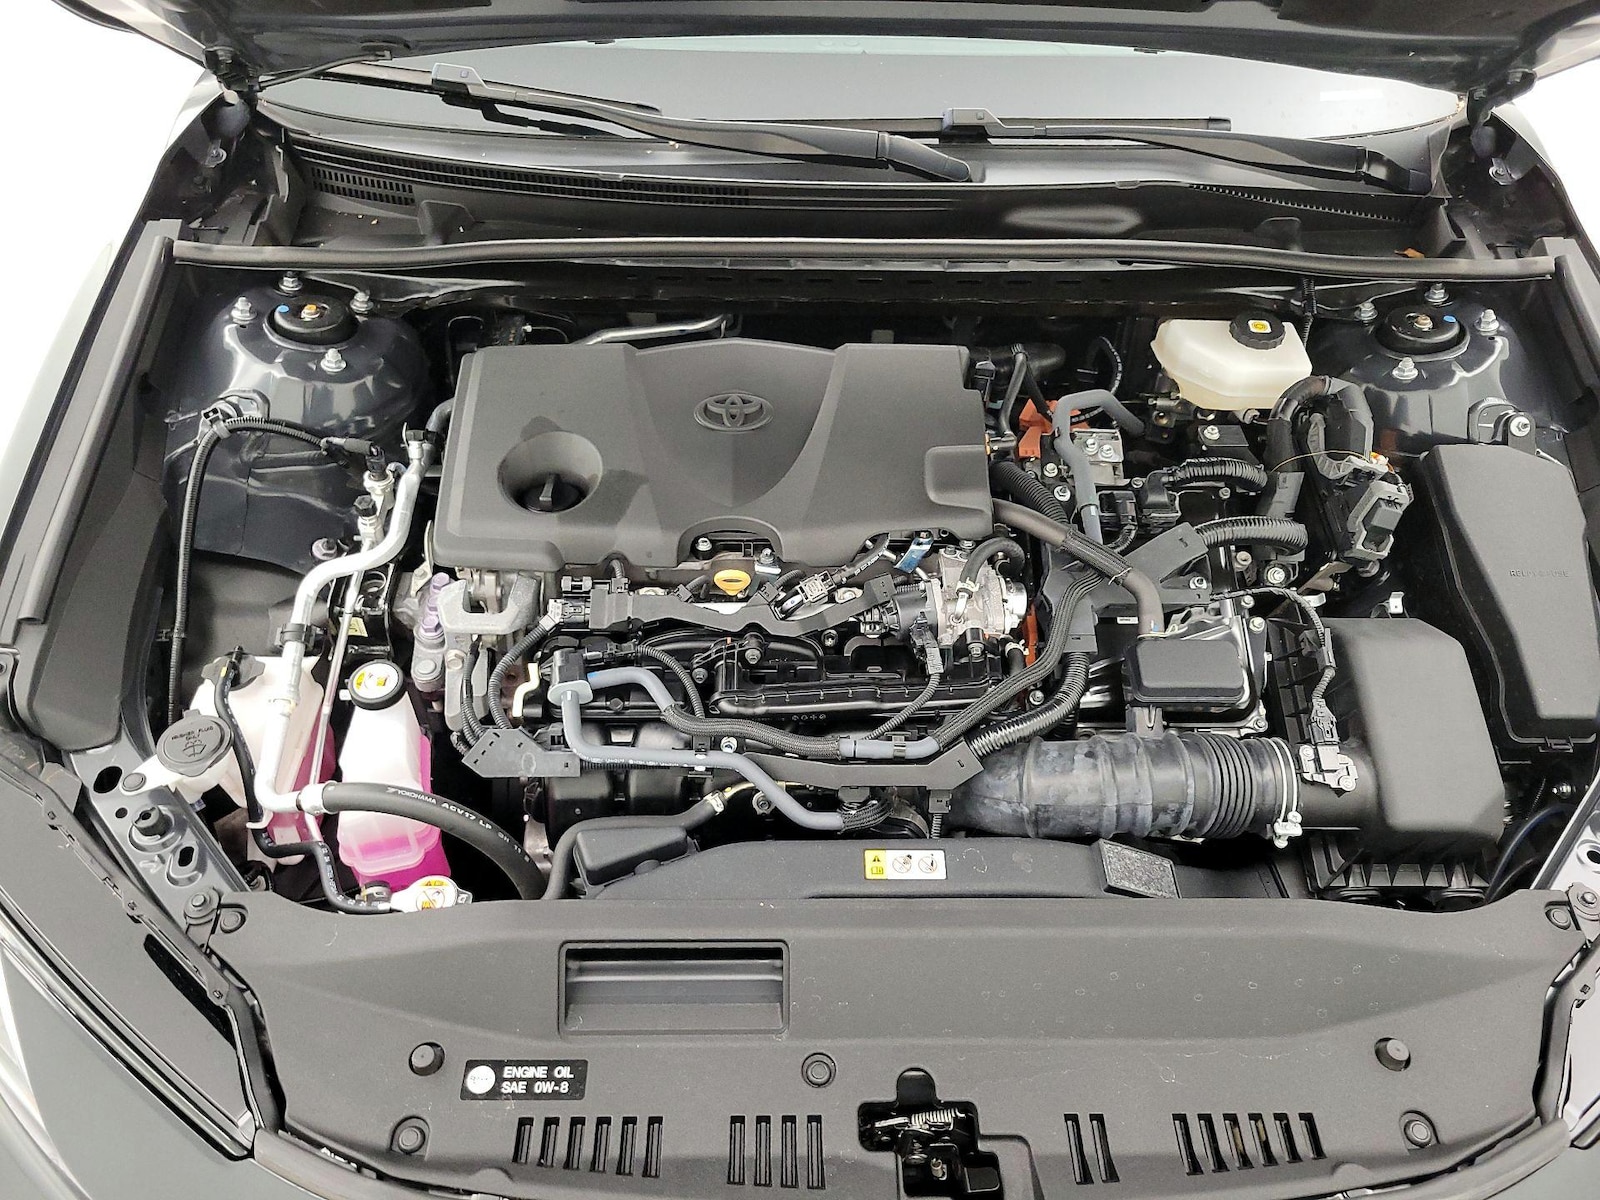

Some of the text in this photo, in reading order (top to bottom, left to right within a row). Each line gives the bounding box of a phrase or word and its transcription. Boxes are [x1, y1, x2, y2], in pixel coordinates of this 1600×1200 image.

[396, 789, 437, 805] YOKOHAMA
[503, 1066, 548, 1079] ENGINE
[554, 1066, 574, 1079] OIL
[501, 1081, 569, 1094] SAE 0W-8
